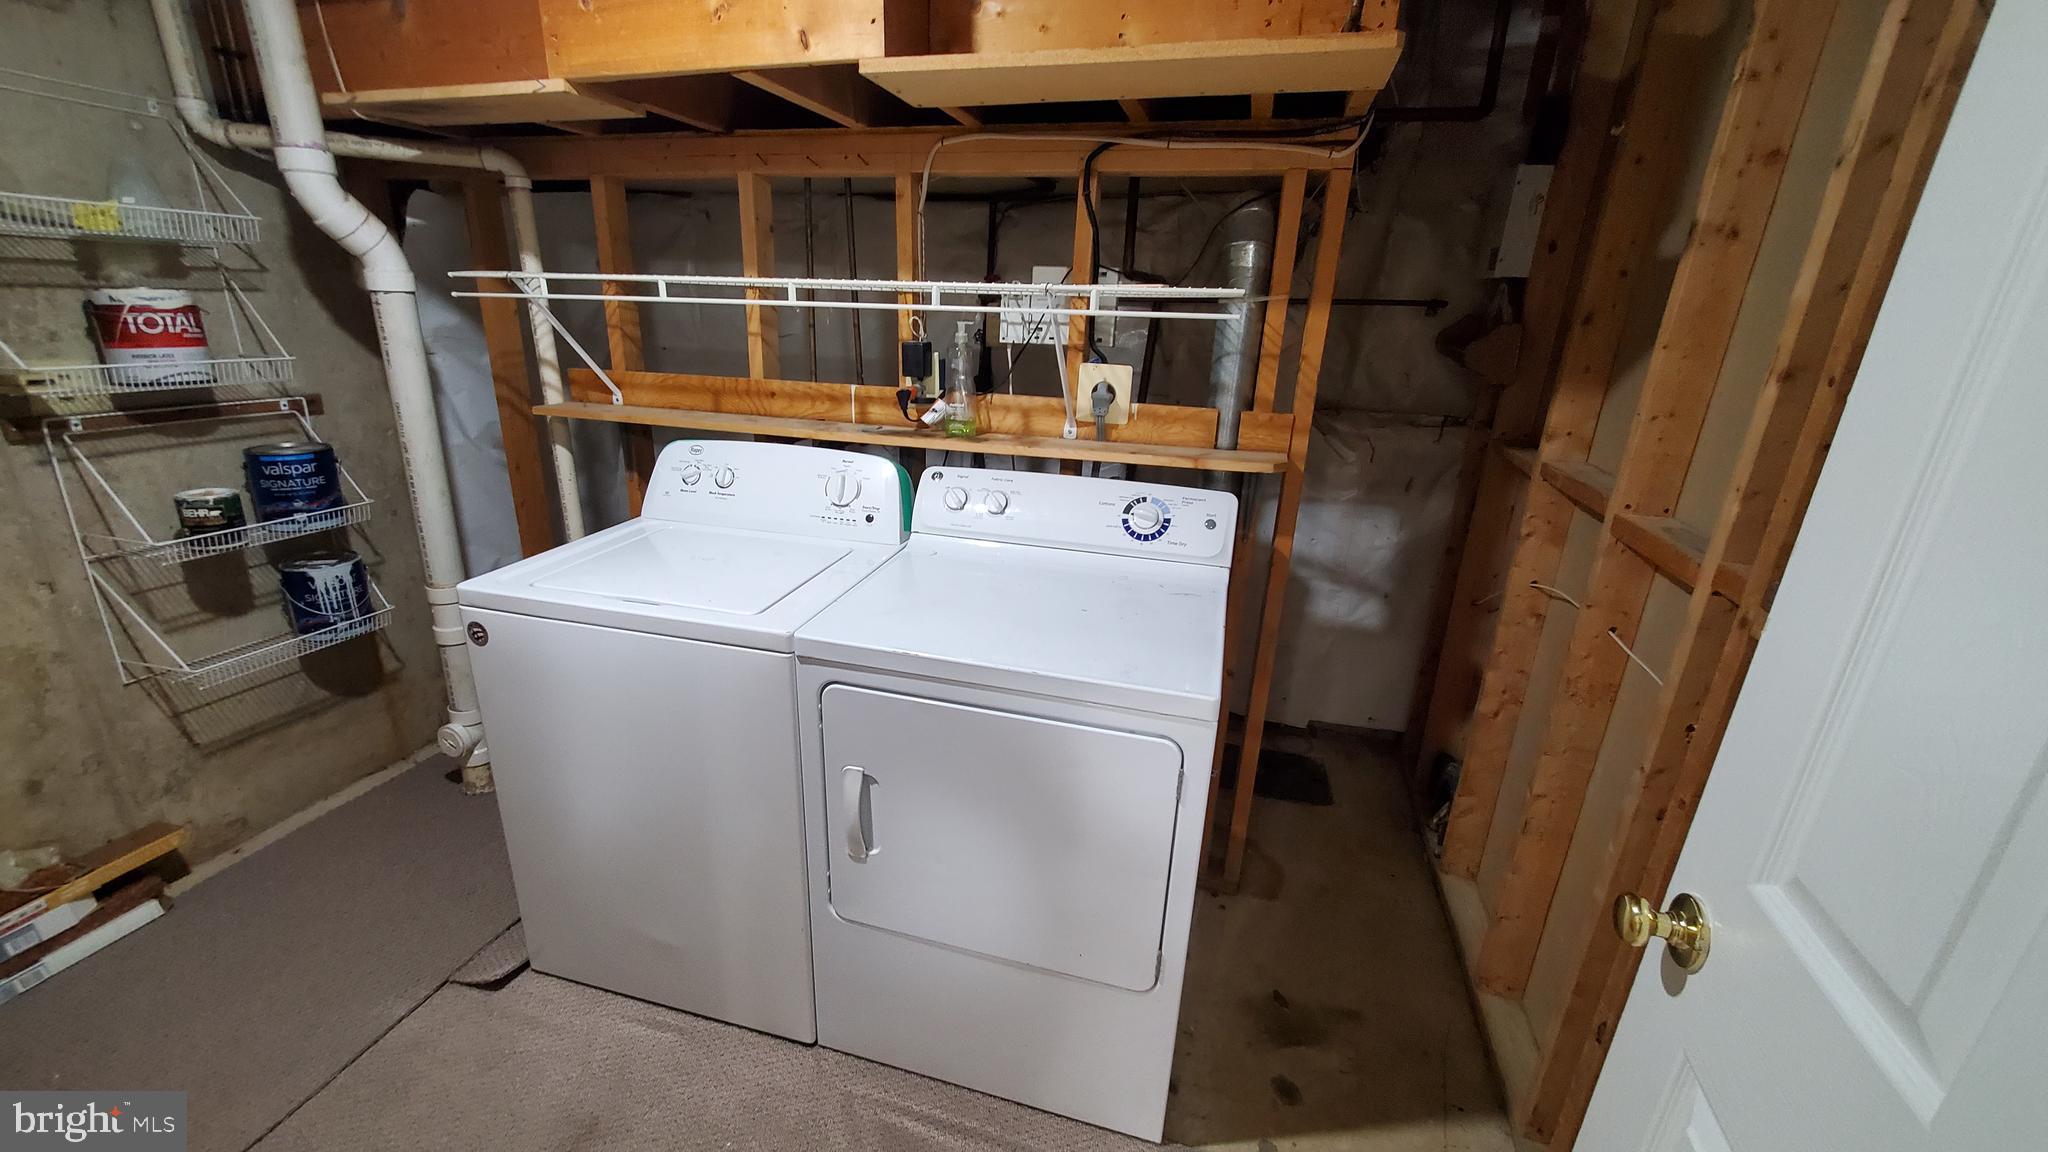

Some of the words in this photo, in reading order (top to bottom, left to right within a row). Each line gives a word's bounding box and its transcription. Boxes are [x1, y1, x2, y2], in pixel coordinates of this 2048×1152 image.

[123, 312, 203, 335] TOTAL
[261, 462, 318, 477] valspar
[259, 475, 327, 489] SIGNATURE
[182, 508, 209, 518] BEHR
